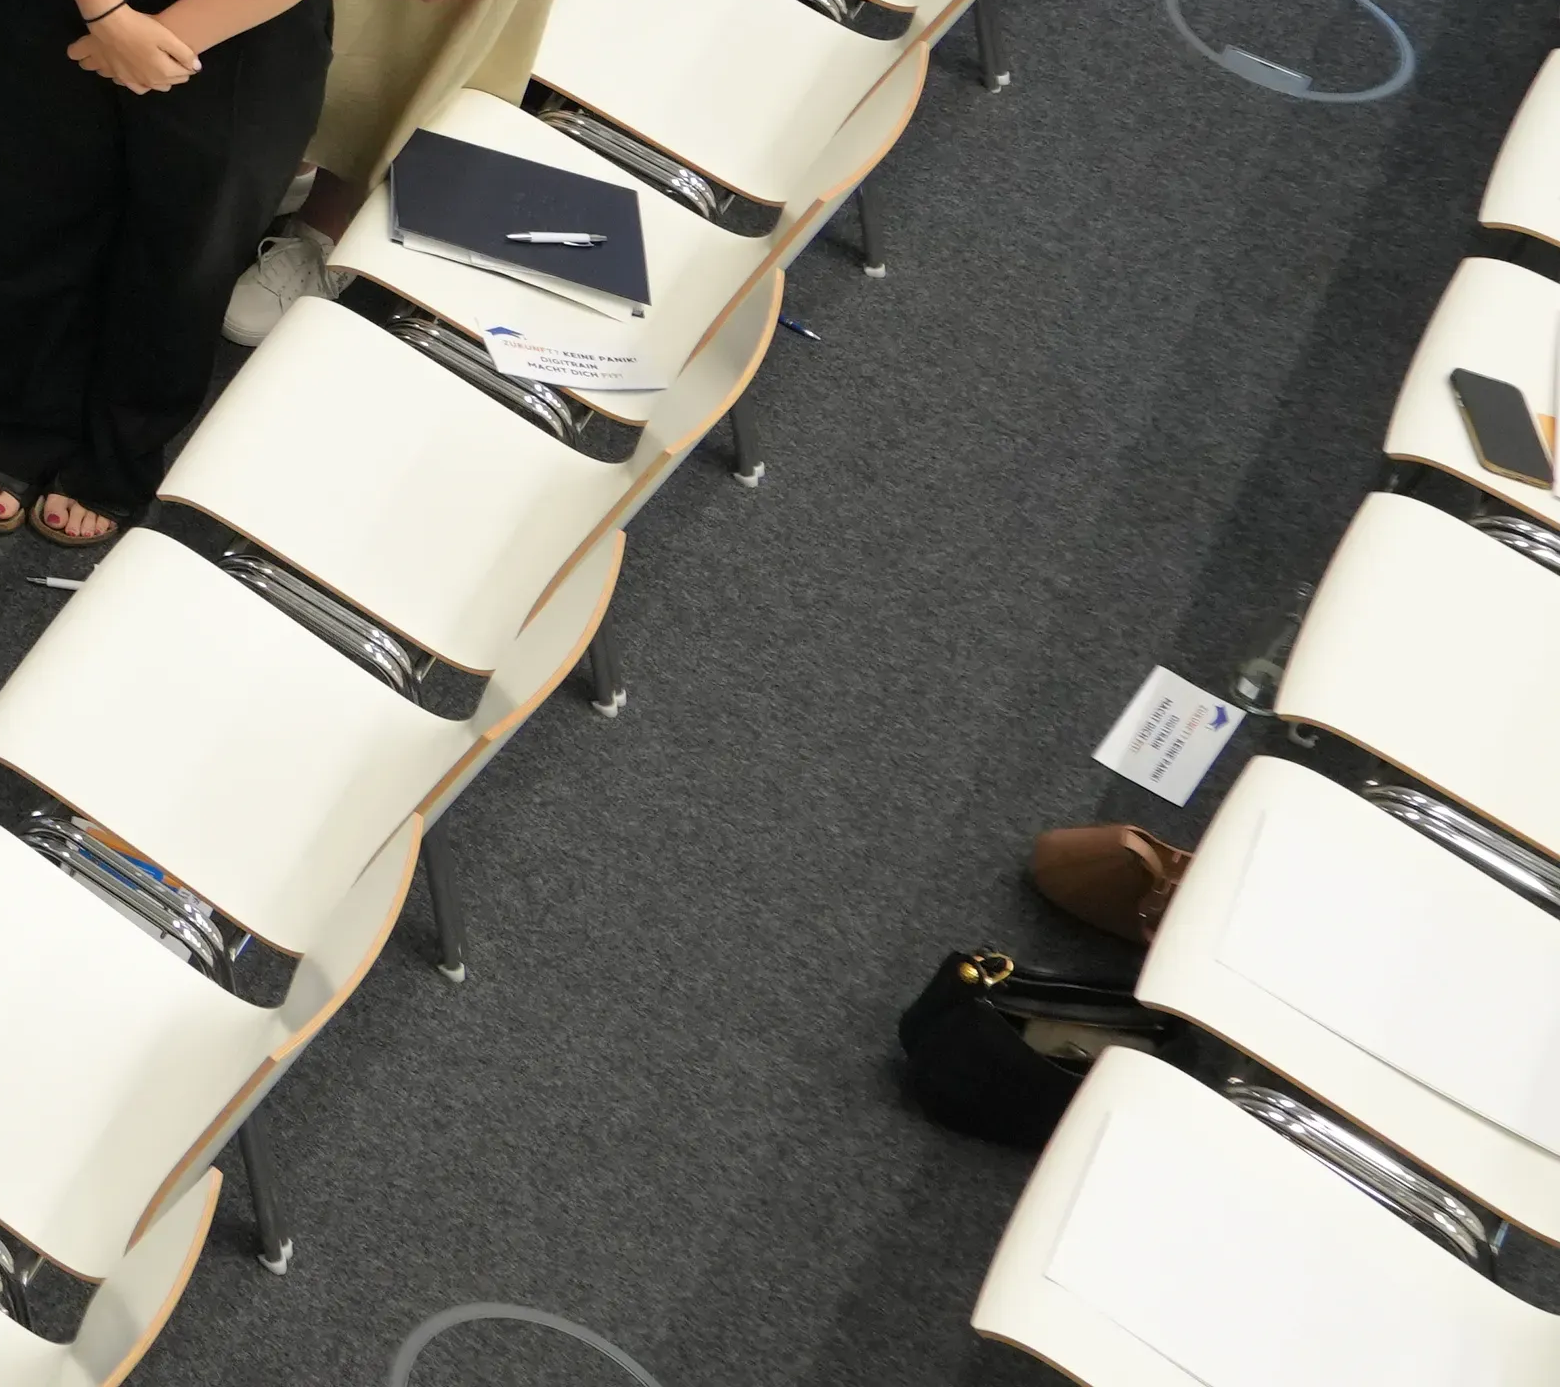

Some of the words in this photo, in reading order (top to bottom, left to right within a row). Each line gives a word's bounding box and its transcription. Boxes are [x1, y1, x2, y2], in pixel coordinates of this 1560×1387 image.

[502, 339, 560, 355] ZUKUNFT?
[562, 351, 596, 362] KEINE
[598, 354, 639, 364] PANIK!
[540, 355, 599, 370] DIGITRAIN
[527, 361, 568, 374] MACHT
[570, 369, 599, 379] DICH
[1154, 696, 1174, 724] MACHT
[1150, 714, 1180, 751] DIGITRAIN
[1165, 738, 1185, 760] KEINE
